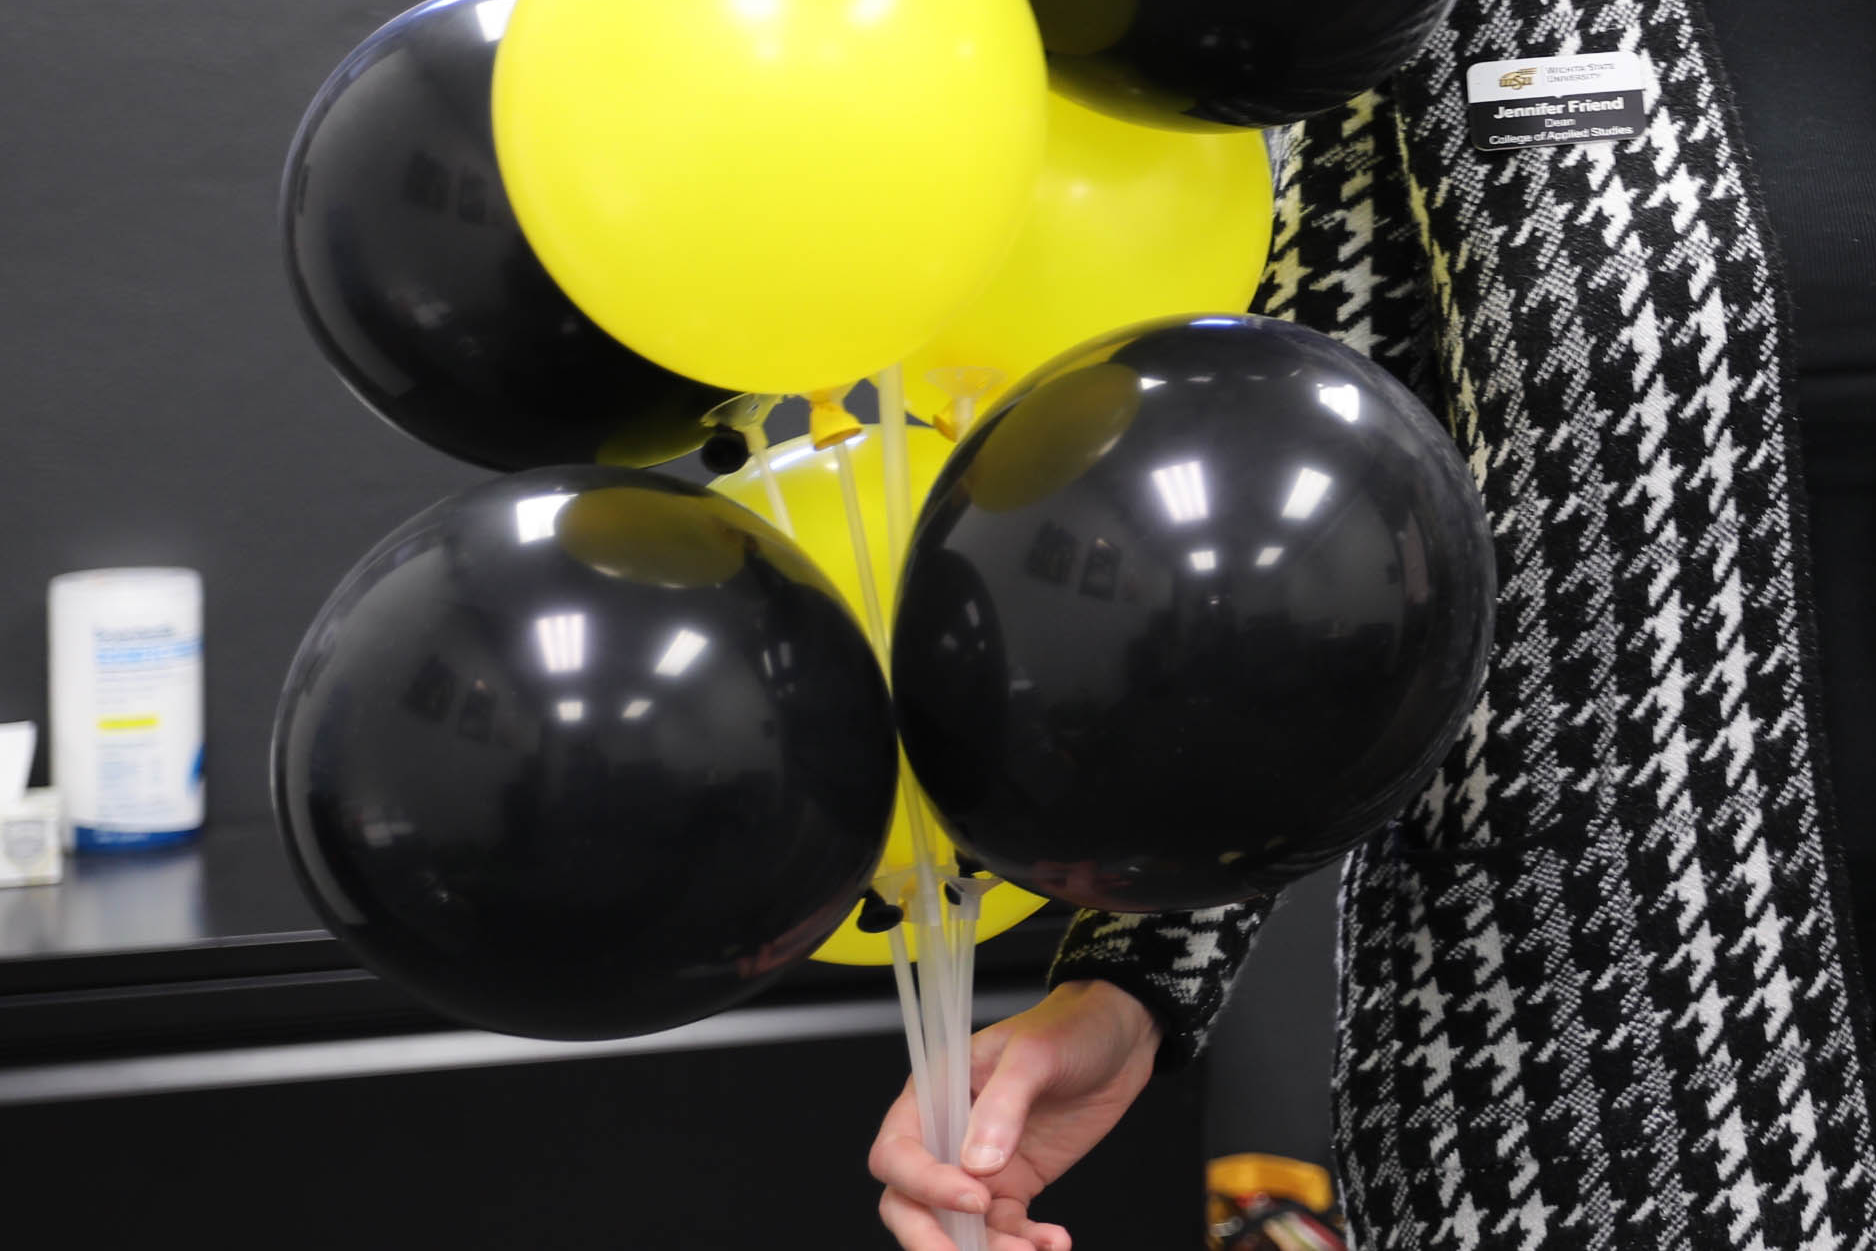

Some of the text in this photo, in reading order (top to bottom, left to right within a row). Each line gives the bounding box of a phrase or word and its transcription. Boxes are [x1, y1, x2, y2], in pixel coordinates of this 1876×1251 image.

[1494, 97, 1625, 119] Jennifer Friend
[1544, 118, 1576, 128] Dean
[1489, 126, 1634, 145] College of Applied Studies
